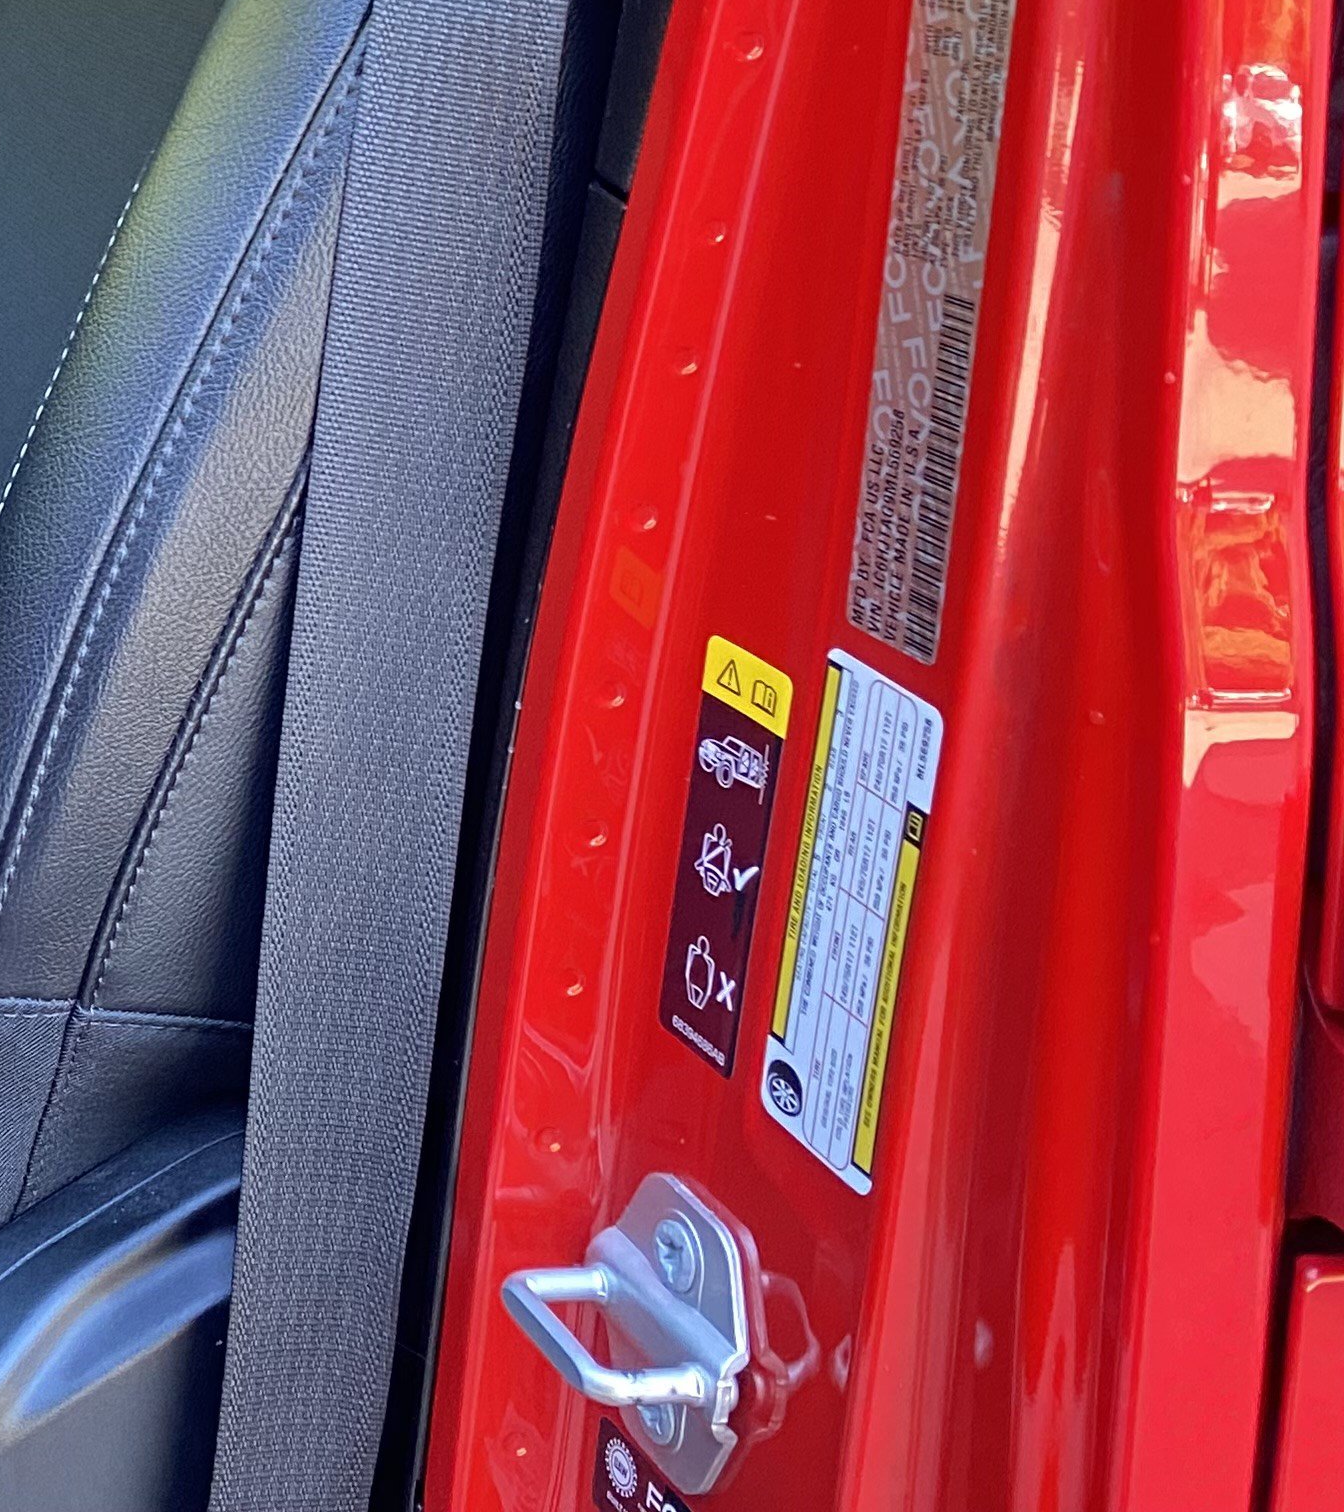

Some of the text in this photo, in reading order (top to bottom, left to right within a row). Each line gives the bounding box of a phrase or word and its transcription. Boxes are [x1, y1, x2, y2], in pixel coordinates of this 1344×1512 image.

[867, 442, 883, 477] LLC
[864, 478, 879, 506] US
[860, 507, 876, 545] FCA
[892, 512, 911, 566] MADE
[884, 569, 904, 644] VEHICLE
[788, 762, 823, 942] TIRE AND LOADING INFORMATION
